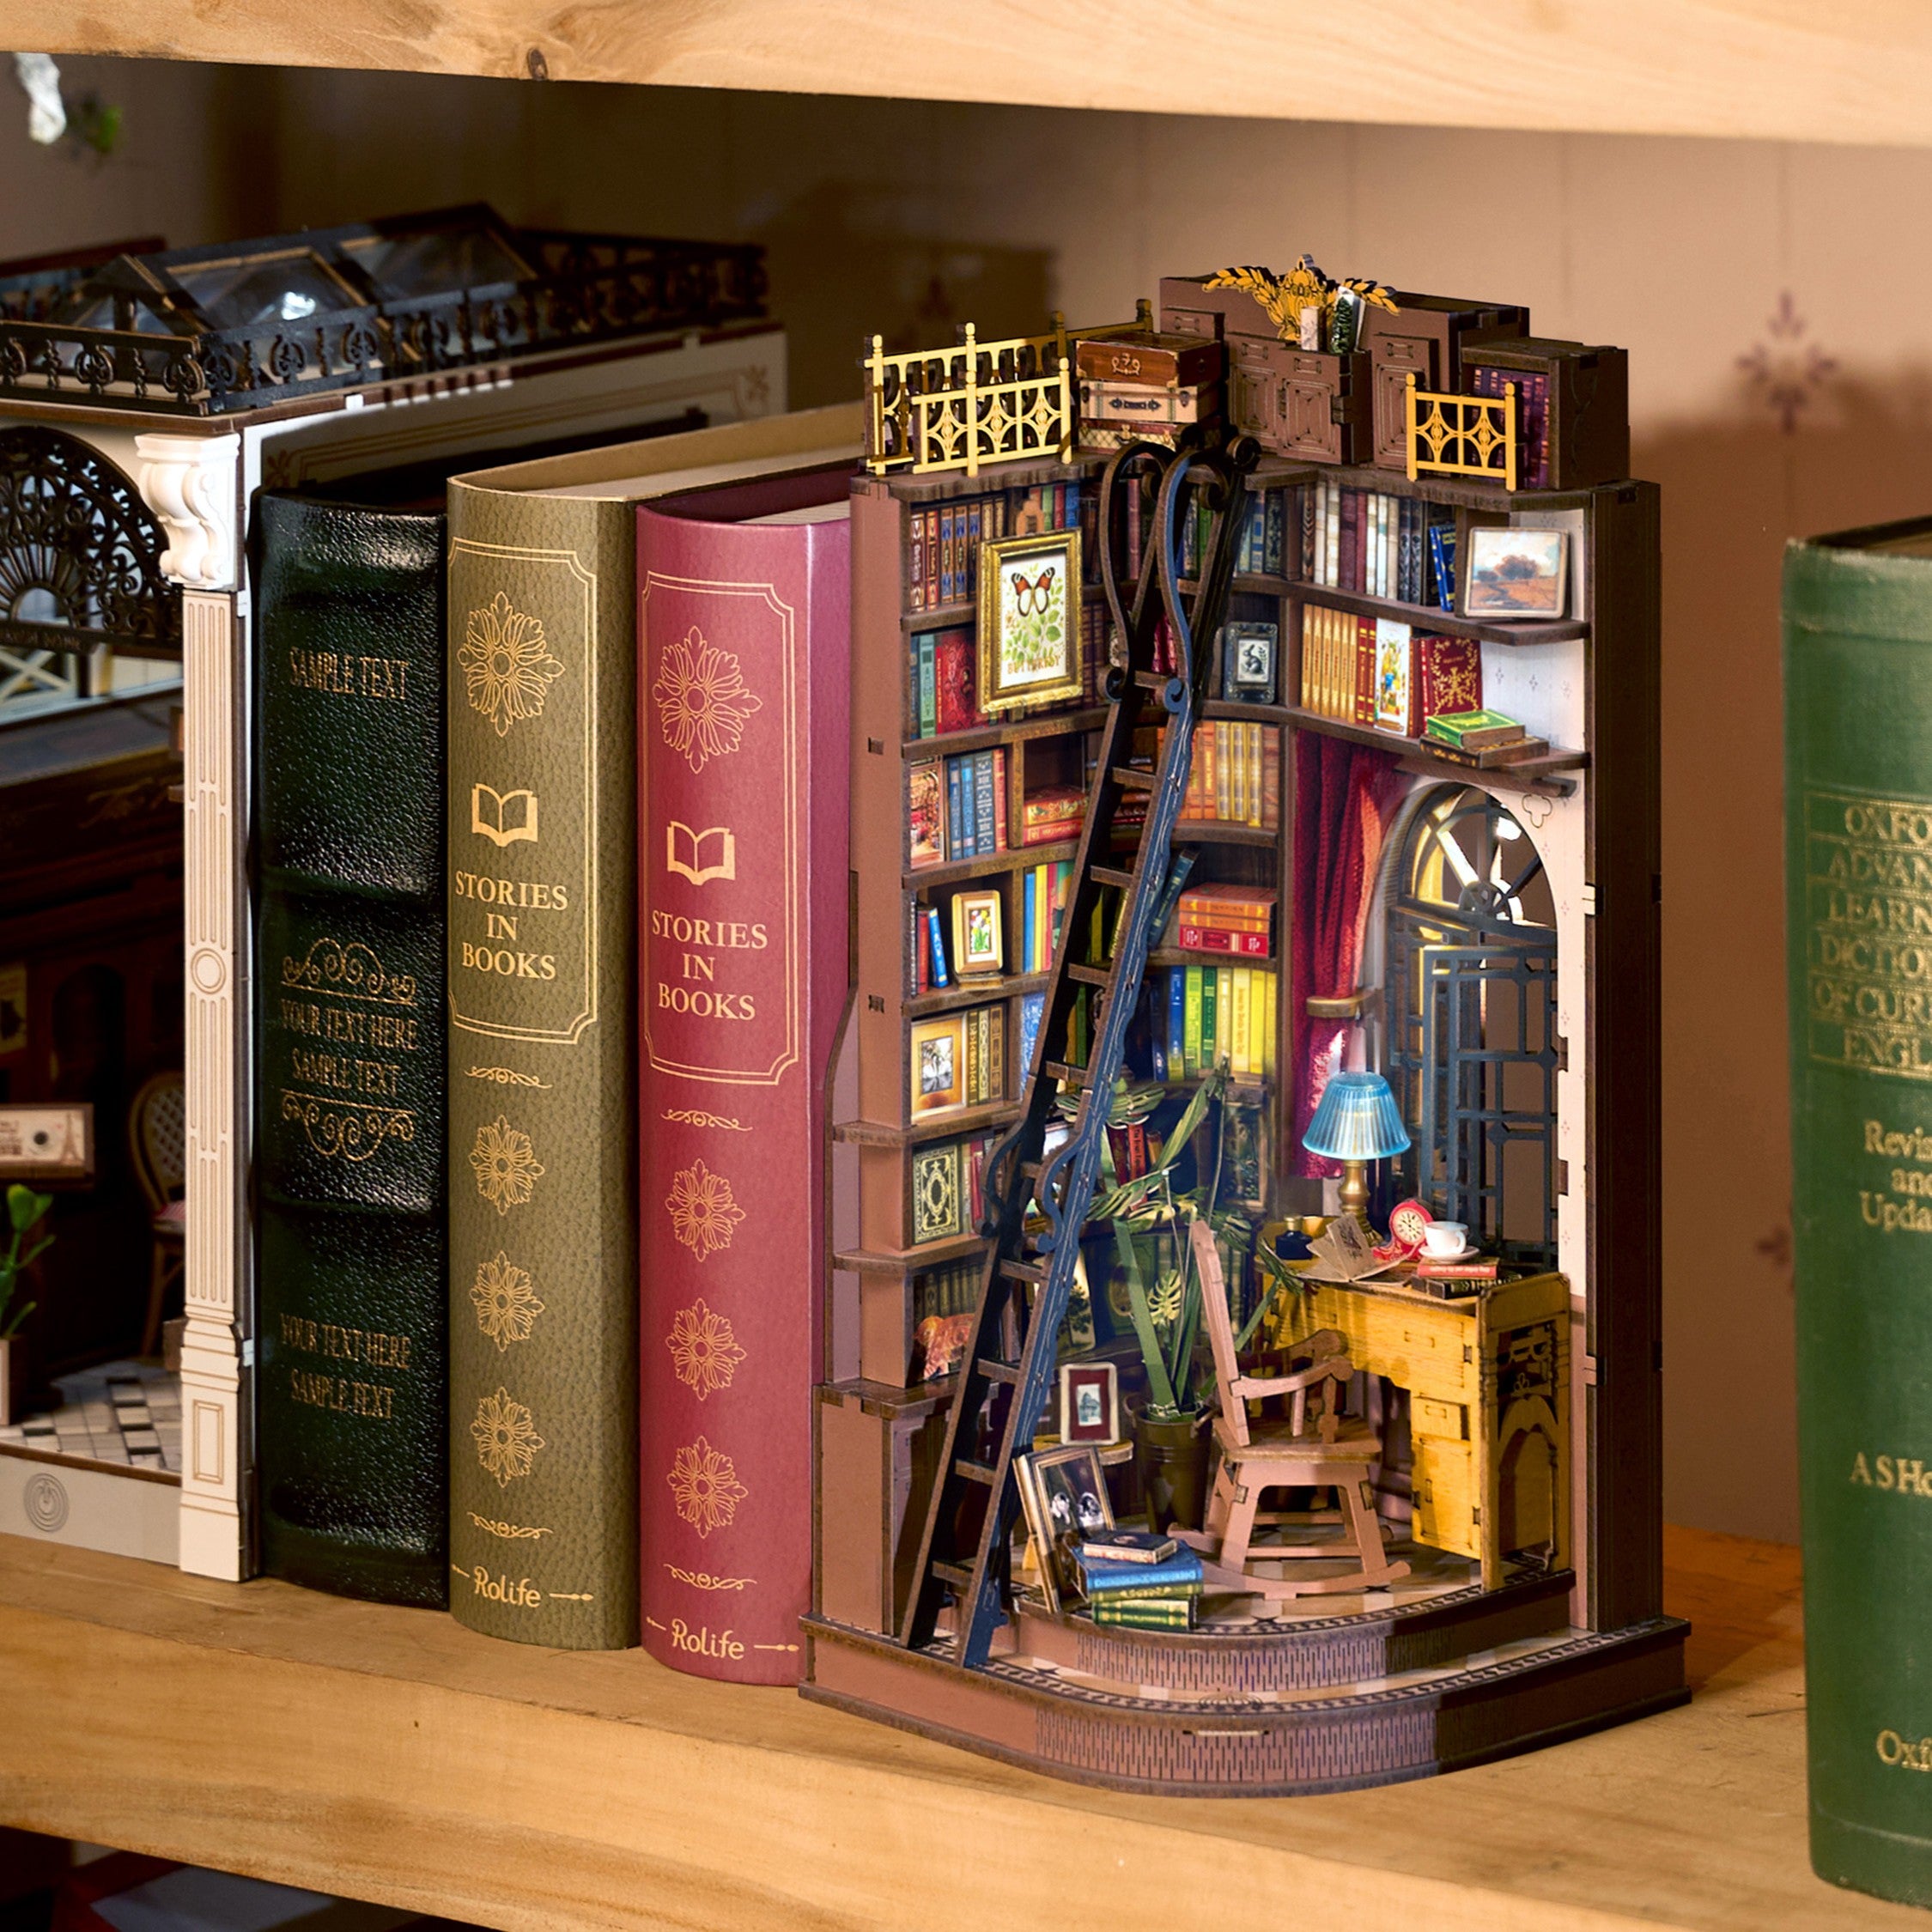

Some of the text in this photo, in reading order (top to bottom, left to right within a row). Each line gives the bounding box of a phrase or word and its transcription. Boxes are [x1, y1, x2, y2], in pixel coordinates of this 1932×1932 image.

[289, 646, 410, 700] SAMPLE TEXT
[455, 870, 568, 910] STORIES
[486, 913, 519, 940] IN
[652, 909, 768, 949] STORIES
[462, 942, 556, 980] BOOKS
[682, 953, 715, 981] IN
[1821, 934, 1932, 979] DICTIO
[658, 982, 756, 1020] BOOKS
[280, 999, 418, 1050] YOUR TEXT HERE
[291, 1048, 401, 1097] SAMPLE TEXT
[280, 1313, 411, 1370] YOUR TEXT HERE
[291, 1368, 395, 1419] SAMPLE TEXT
[473, 1565, 541, 1607] Rolife
[671, 1618, 744, 1660] Rolife
